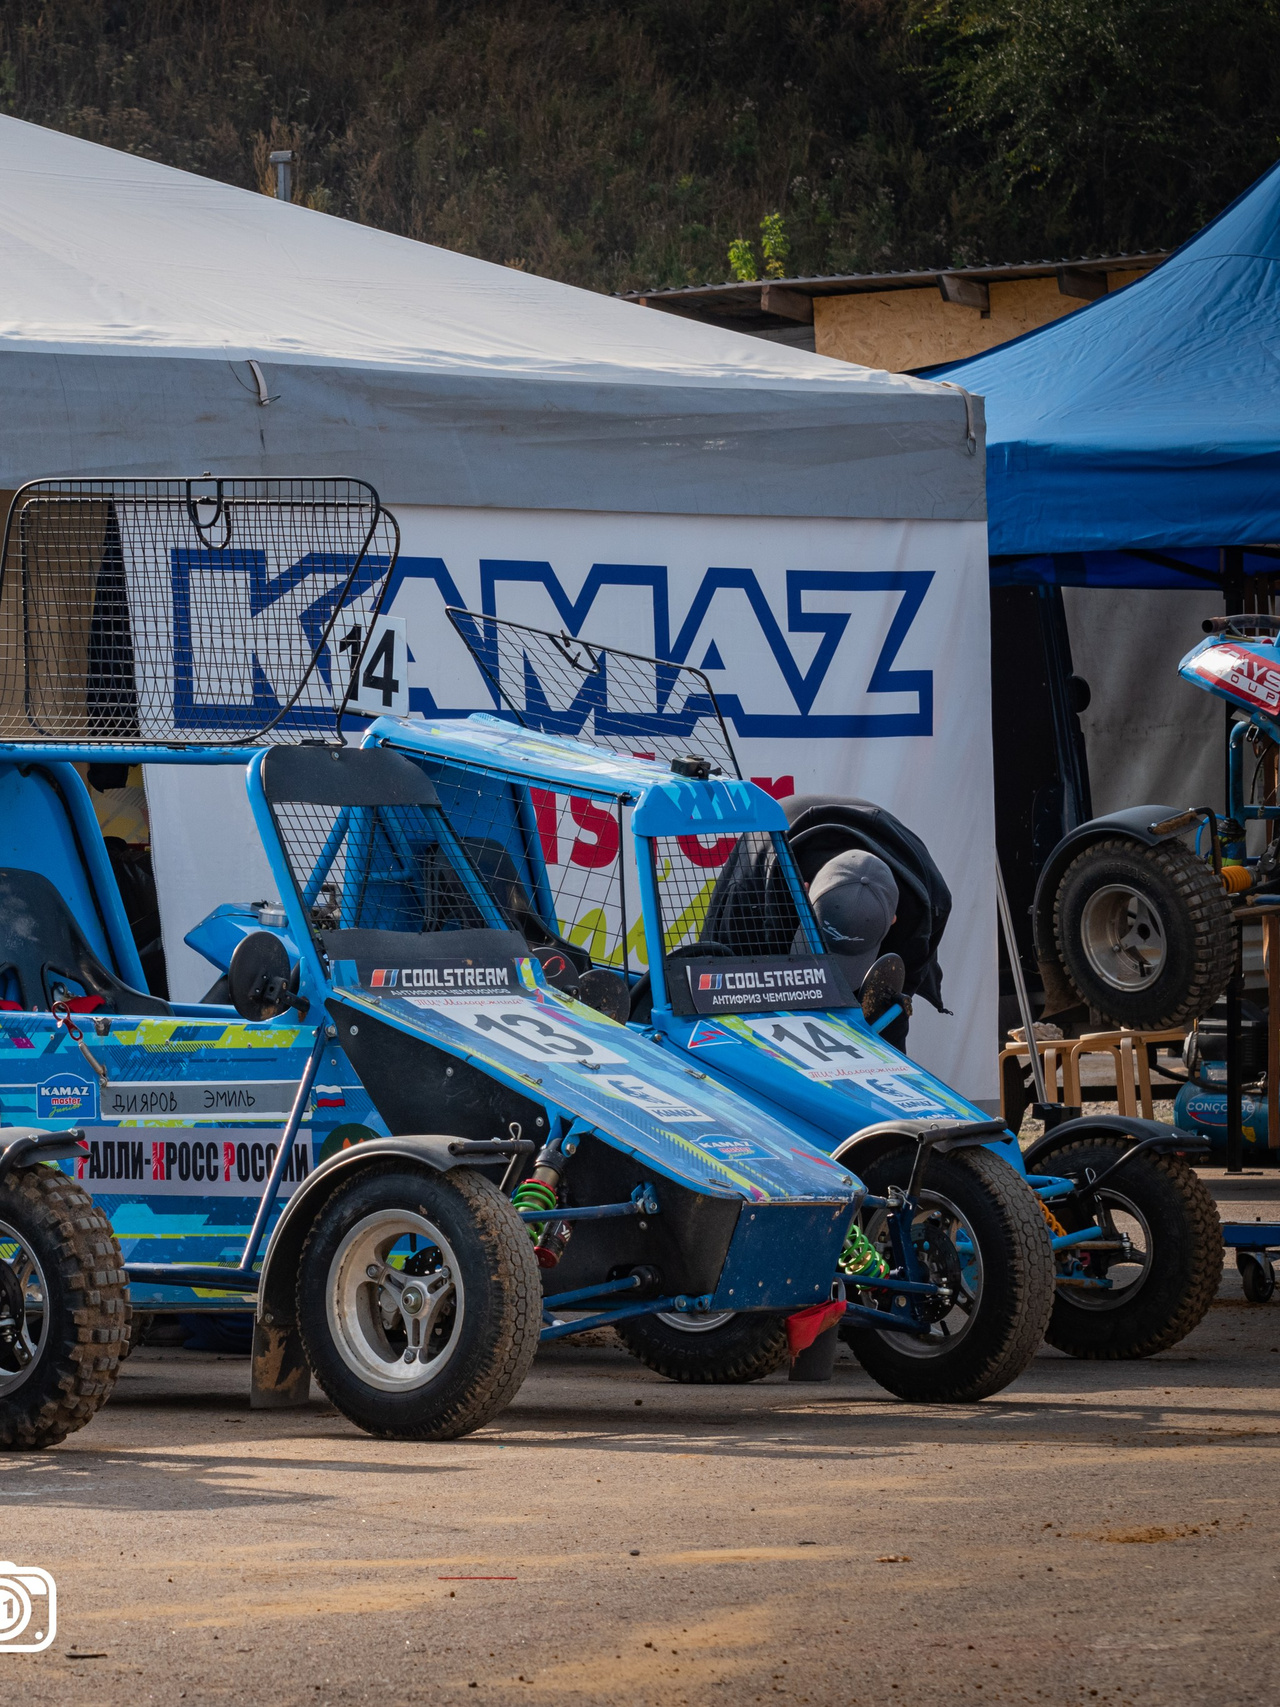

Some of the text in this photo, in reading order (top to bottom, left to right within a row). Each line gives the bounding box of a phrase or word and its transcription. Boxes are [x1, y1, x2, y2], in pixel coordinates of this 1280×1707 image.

[171, 548, 936, 738] KAMAZ
[339, 624, 399, 707] 14
[402, 968, 509, 987] COOLSTREAM
[724, 968, 826, 990] COOLSTREAM
[712, 990, 823, 1005] АНТИФРИЗ ЧЕМПИОНОВ
[474, 1014, 593, 1056] 13
[771, 1022, 864, 1062] 14
[40, 1086, 89, 1096] KAMAZ
[49, 1103, 83, 1118] Junior
[51, 1096, 81, 1106] master
[112, 1090, 256, 1113] ДИЯРОВ ЭМИЛЬ
[898, 1100, 936, 1109] KAMAZ
[651, 1109, 703, 1117] KAMAZ
